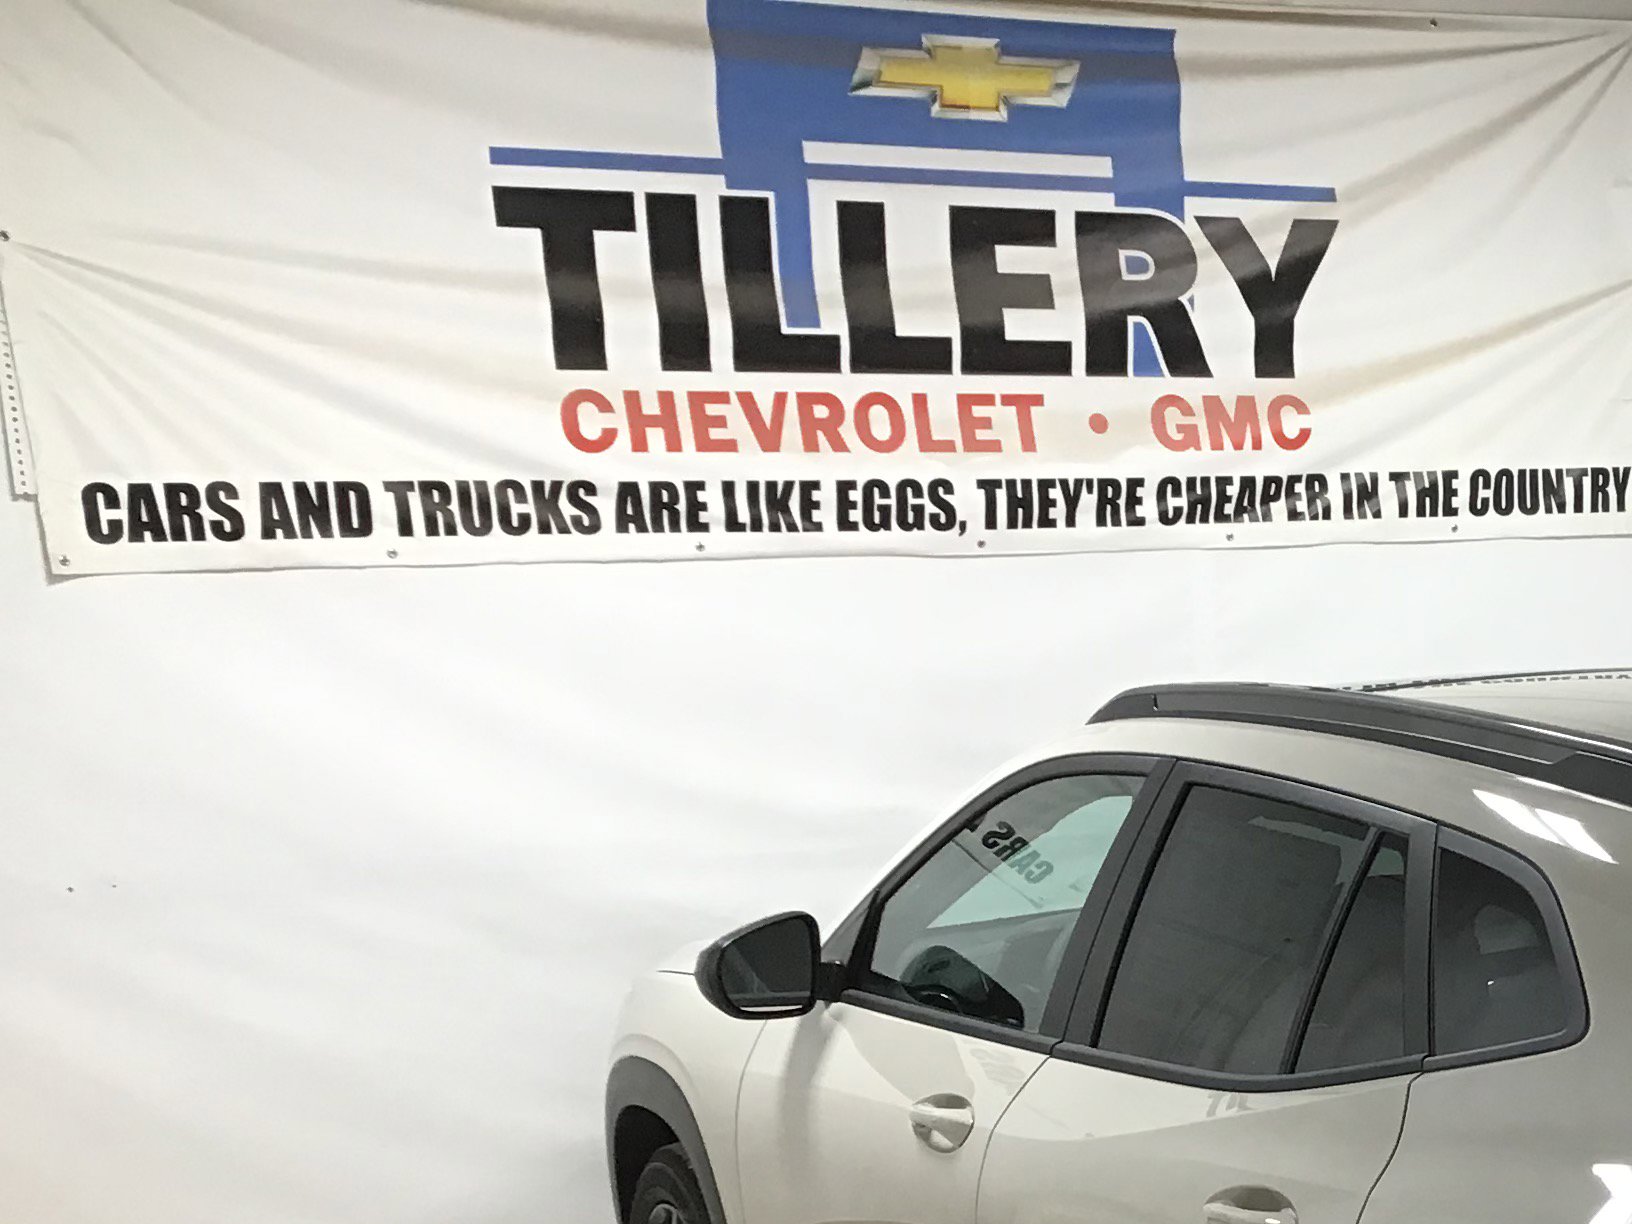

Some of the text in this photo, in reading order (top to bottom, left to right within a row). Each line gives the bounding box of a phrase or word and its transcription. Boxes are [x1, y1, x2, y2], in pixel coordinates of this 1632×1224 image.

[491, 186, 1340, 379] TILLERY
[559, 389, 1312, 454] CHEVROLET GMC
[82, 466, 1632, 545] CARS AND TRUCKS ARE LIKE EGGS, THEY'RE CHEAPER IN THE COUNTRY
